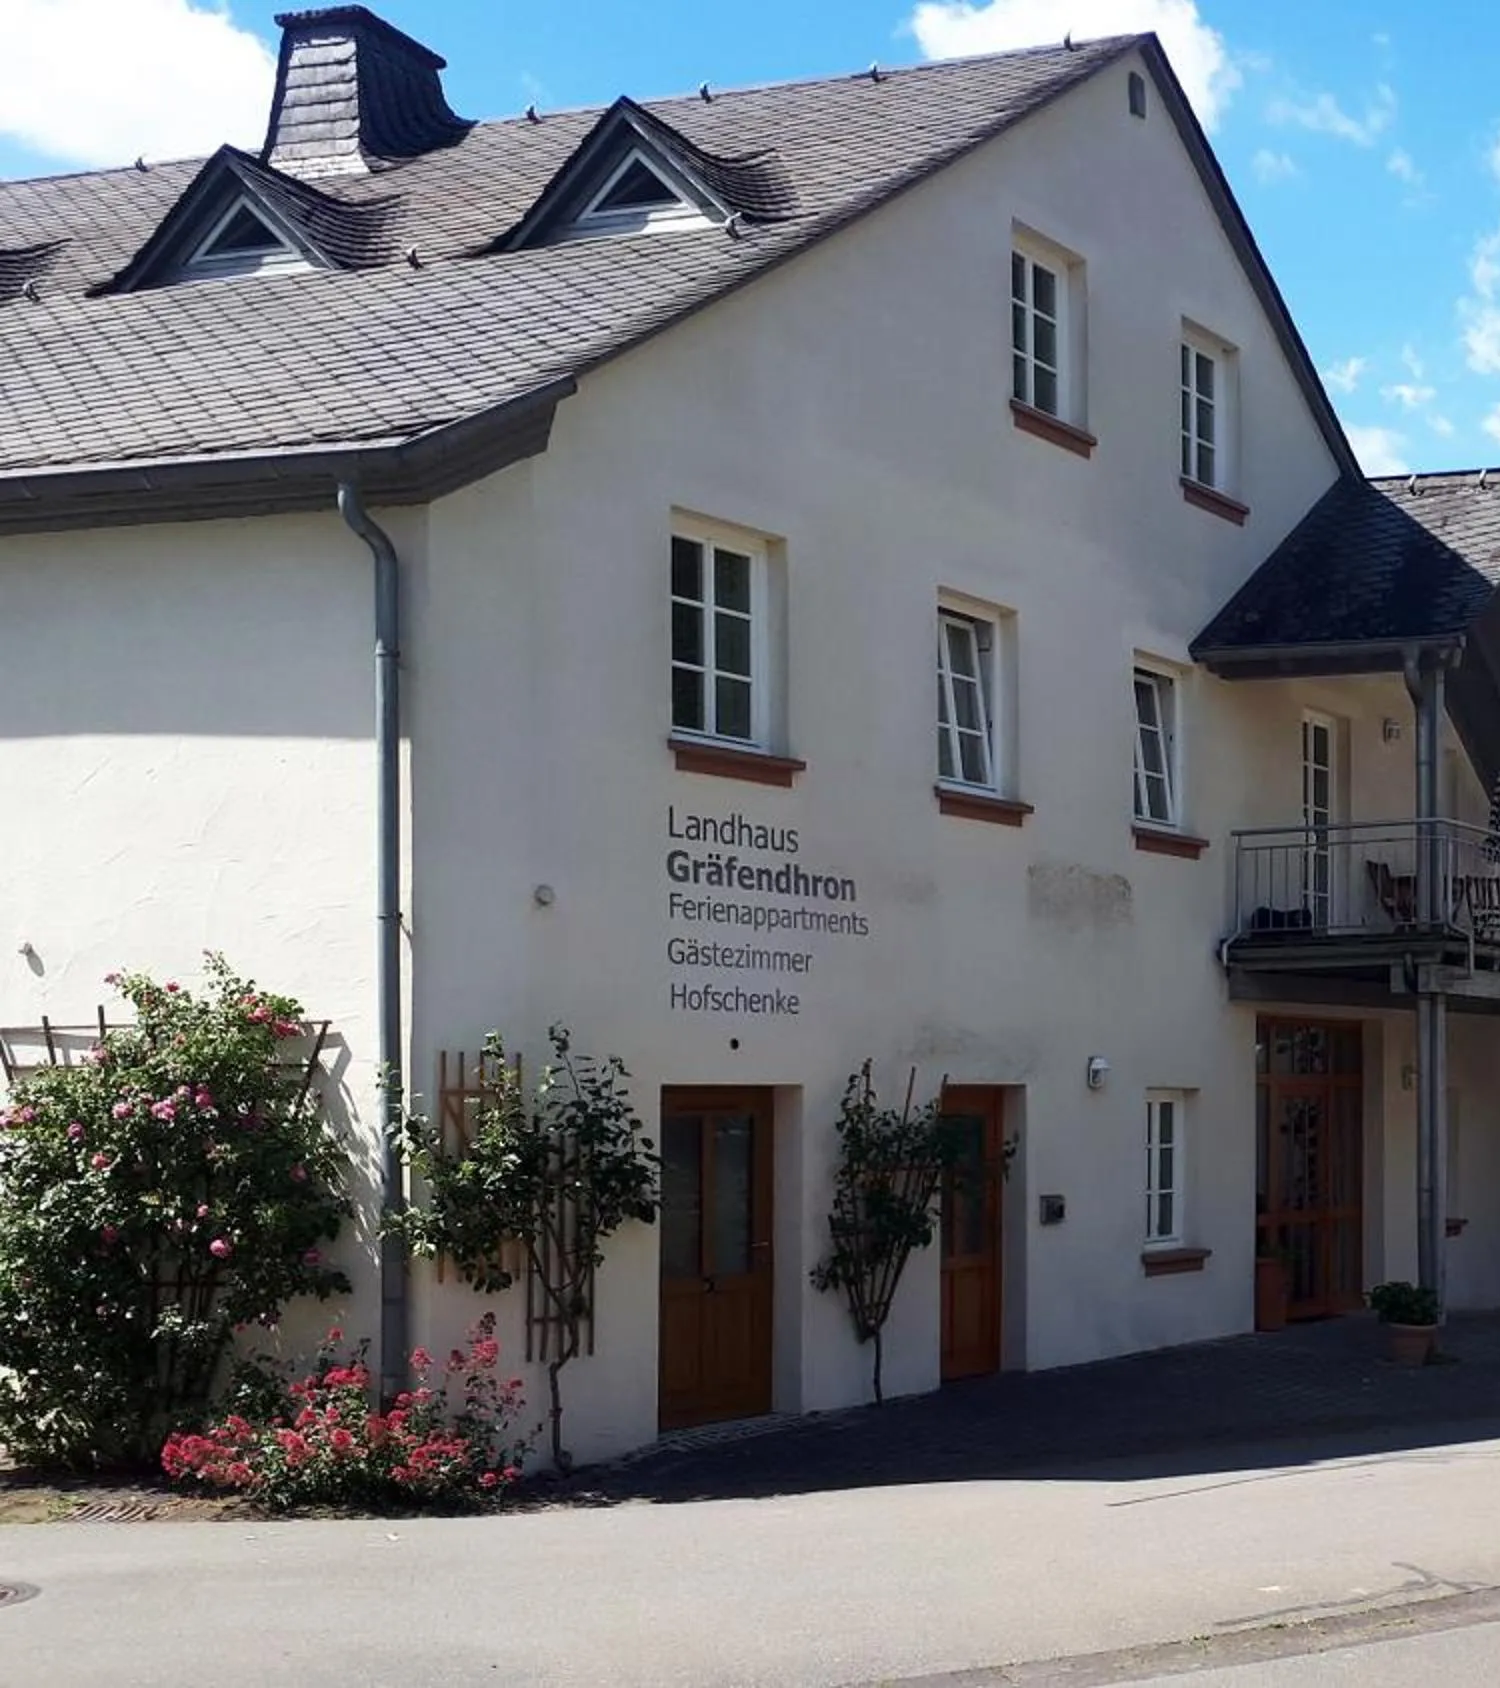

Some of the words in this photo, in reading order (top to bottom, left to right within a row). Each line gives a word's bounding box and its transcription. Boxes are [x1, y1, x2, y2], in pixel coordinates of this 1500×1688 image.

[668, 805, 799, 853] Landhaus
[667, 850, 856, 901] Gräfendhron
[669, 893, 869, 936] Ferienappartments
[667, 937, 813, 973] Gästezimmer
[671, 983, 799, 1015] Hofschenke
